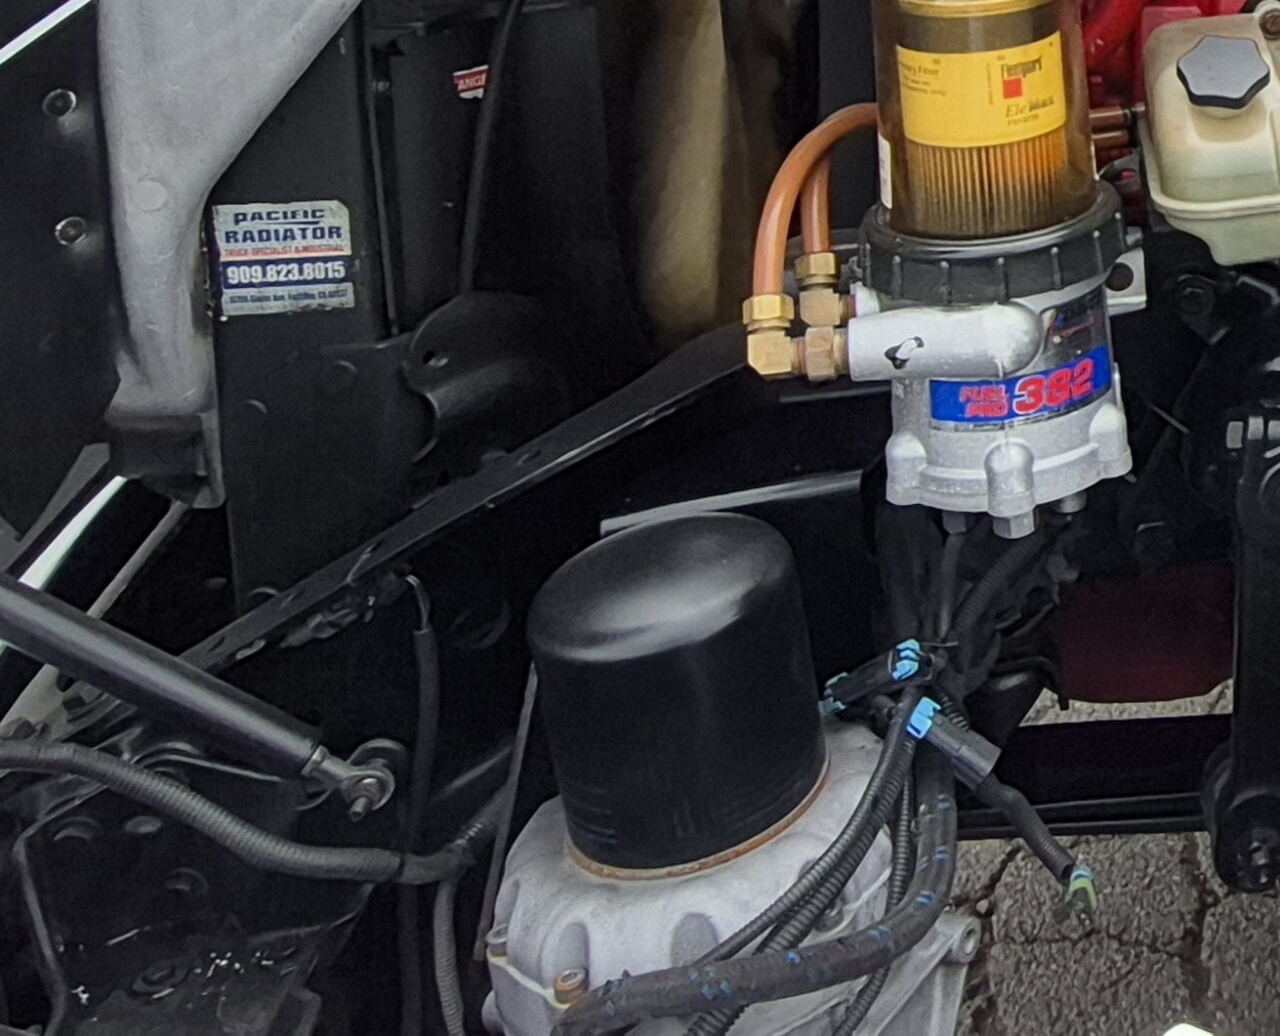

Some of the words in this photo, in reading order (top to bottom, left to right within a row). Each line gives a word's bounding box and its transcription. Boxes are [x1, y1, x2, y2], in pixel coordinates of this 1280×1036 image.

[233, 208, 325, 225] PACIFIC
[224, 226, 342, 244] RADIATOR
[226, 261, 345, 284] 909.823.8015
[1013, 357, 1094, 415] 382
